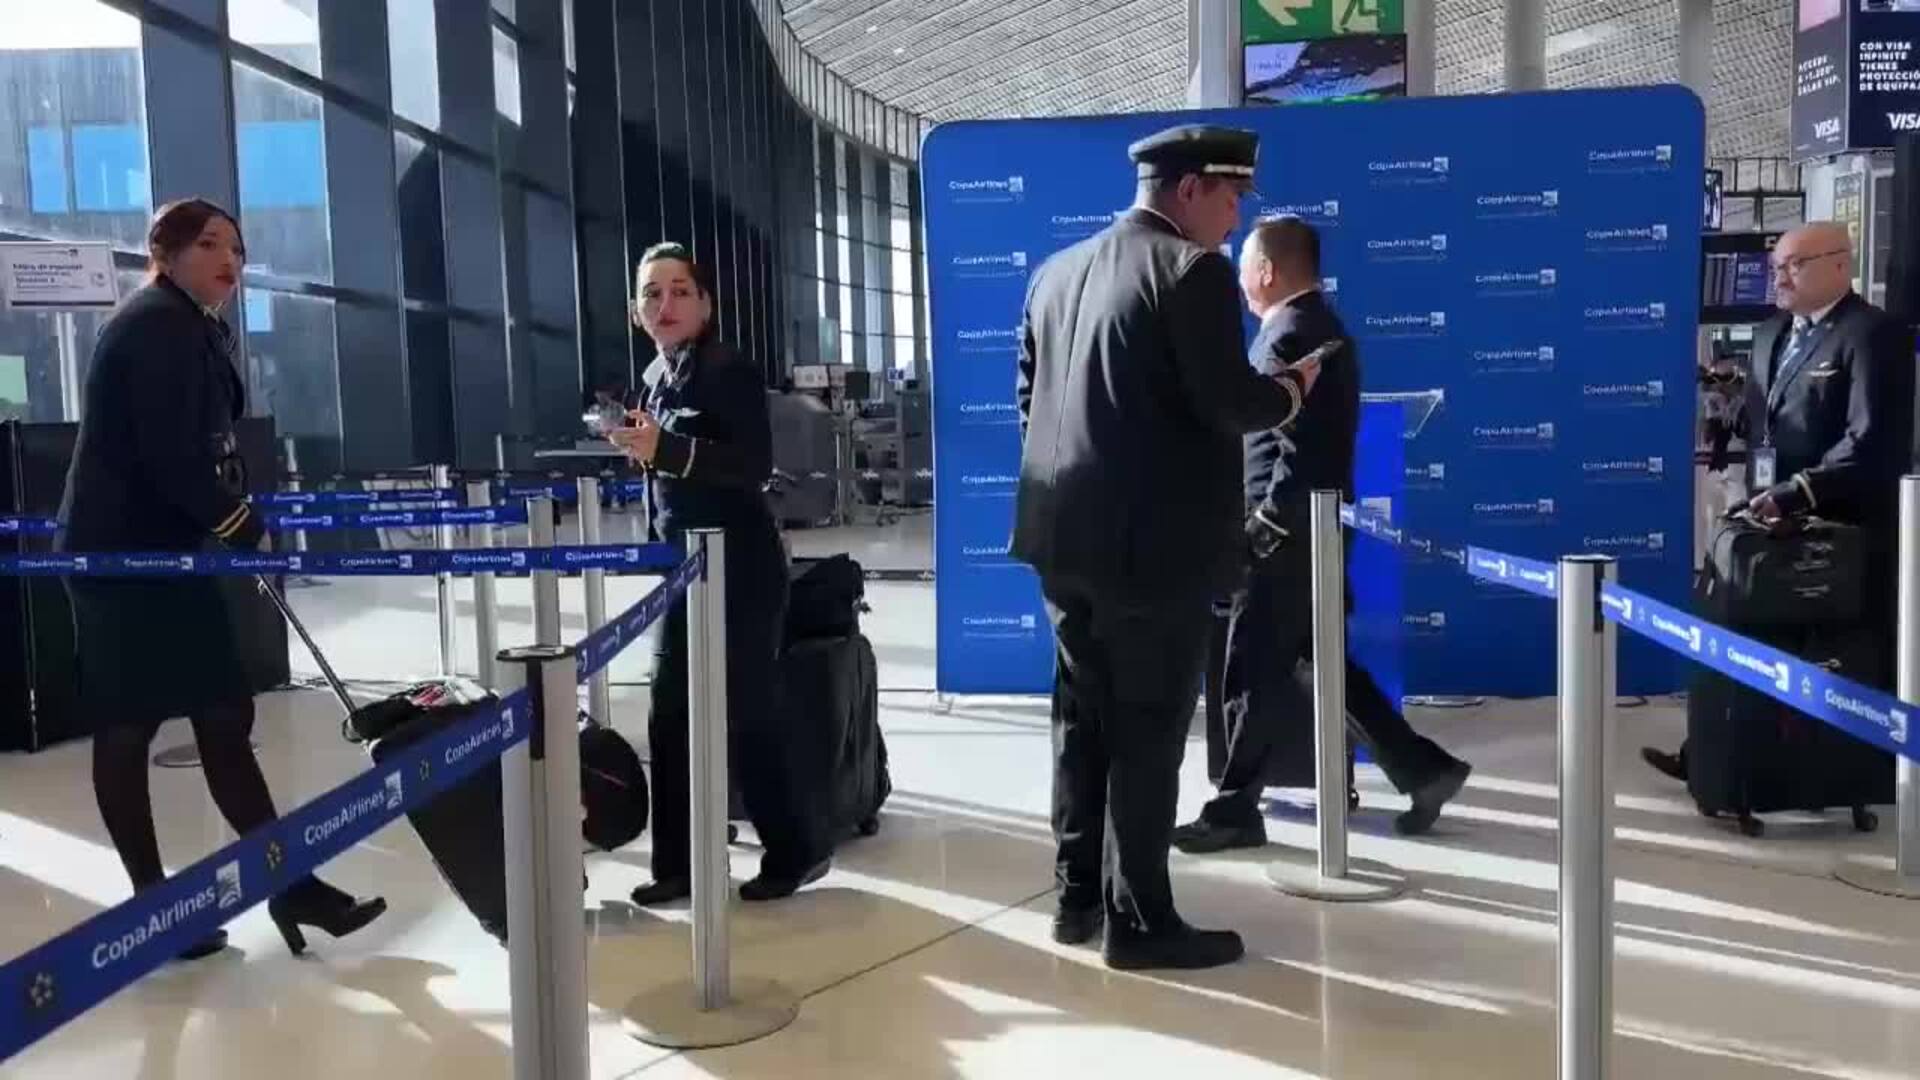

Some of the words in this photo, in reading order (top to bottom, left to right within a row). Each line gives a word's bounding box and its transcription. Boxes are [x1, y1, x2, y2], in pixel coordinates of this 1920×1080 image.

[1860, 42, 1882, 51] CON
[1886, 41, 1911, 50] VISA
[1860, 51, 1907, 60] INFINITE
[1860, 61, 1898, 70] TIENES
[1860, 82, 1873, 91] DE
[1813, 117, 1841, 139] VISA
[1825, 688, 1890, 727] CopaAirlines
[445, 723, 502, 765] CopaAirlines
[304, 788, 385, 846] CopaAirlines
[91, 884, 217, 970] CopaAirlines
